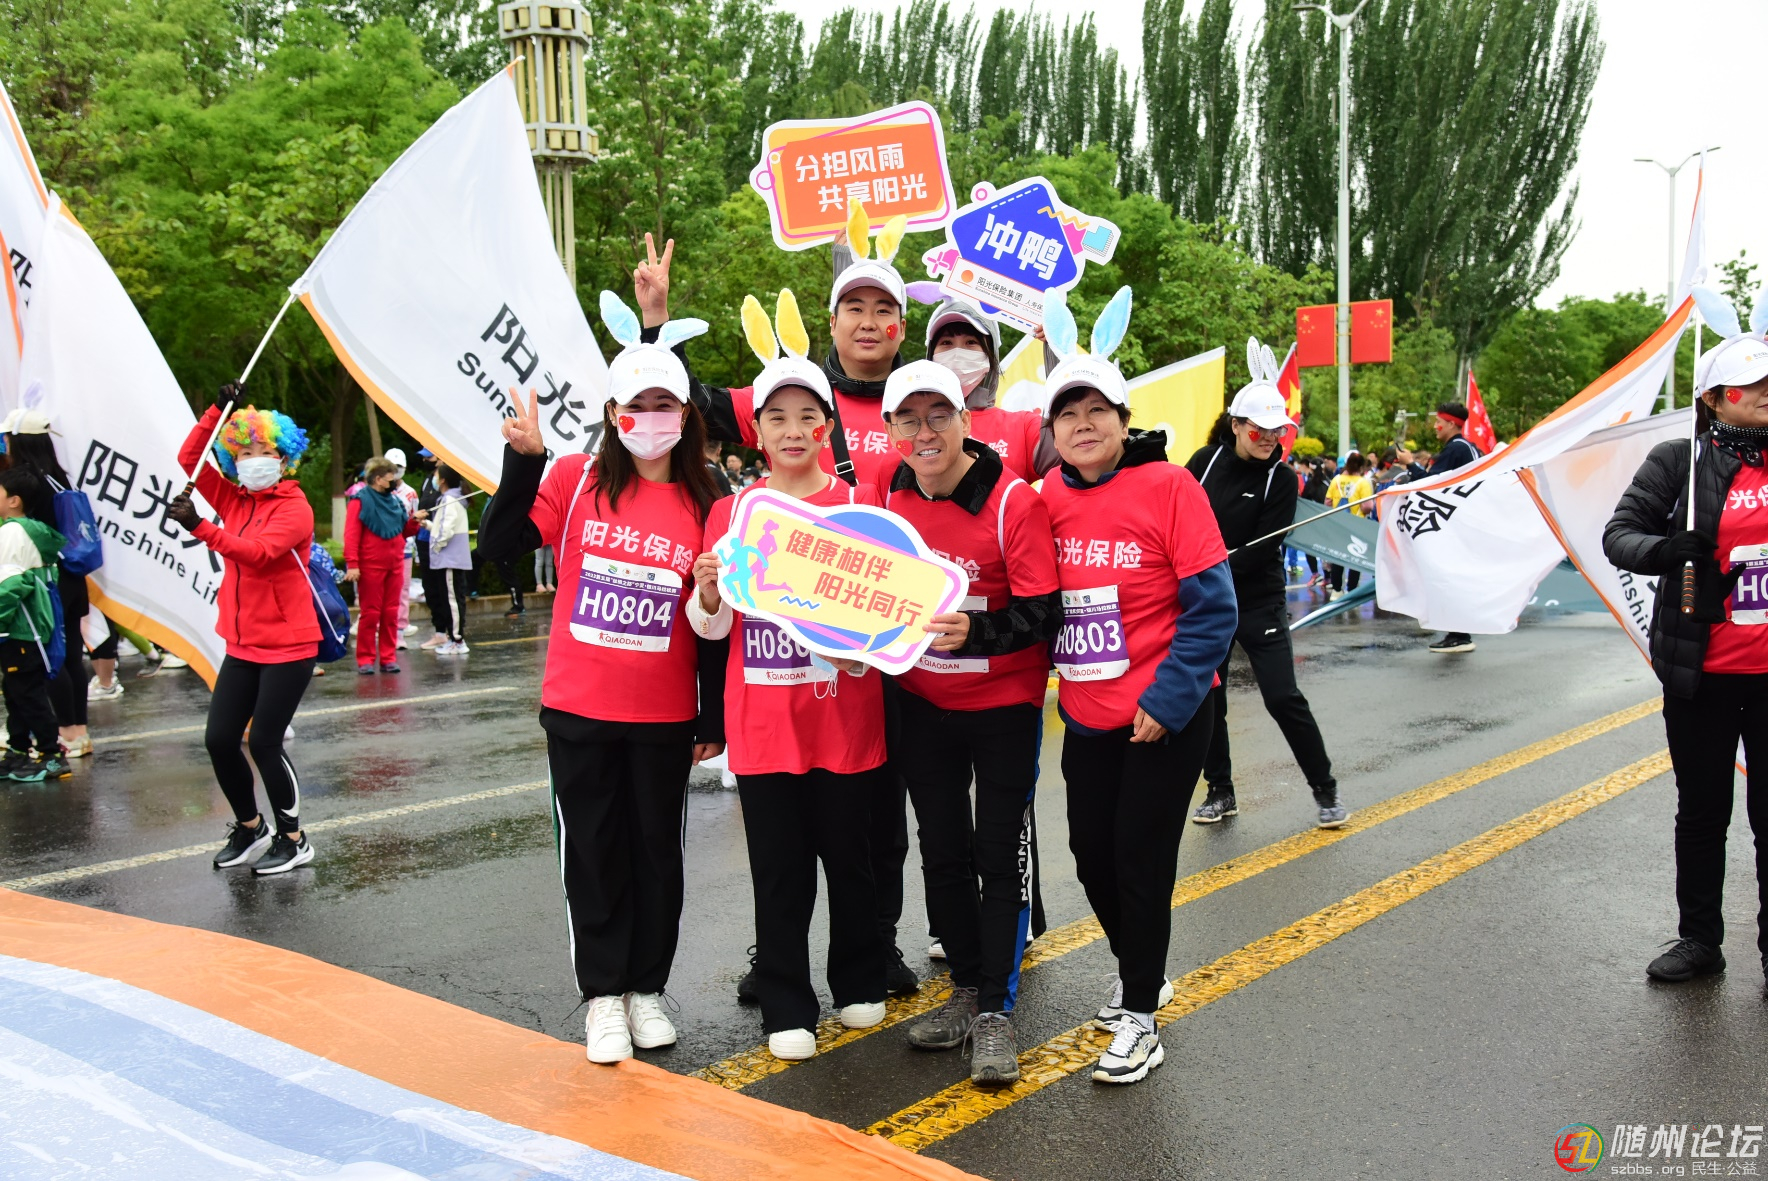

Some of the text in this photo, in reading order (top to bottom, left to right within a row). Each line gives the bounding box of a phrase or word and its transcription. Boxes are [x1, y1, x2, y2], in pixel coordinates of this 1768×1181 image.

[795, 142, 905, 183] 分担风雨
[817, 173, 928, 213] 共享阳光
[974, 213, 1064, 281] 冲鸭
[581, 519, 694, 576] 阳光保险
[785, 528, 894, 582] 健康相伴
[578, 586, 673, 628] H0804
[813, 571, 924, 627] 阳光同行
[604, 635, 643, 647] QIAODAN
[1054, 619, 1122, 656] H0803
[772, 674, 807, 682] QIAODAN
[924, 658, 960, 670] QIAODAN
